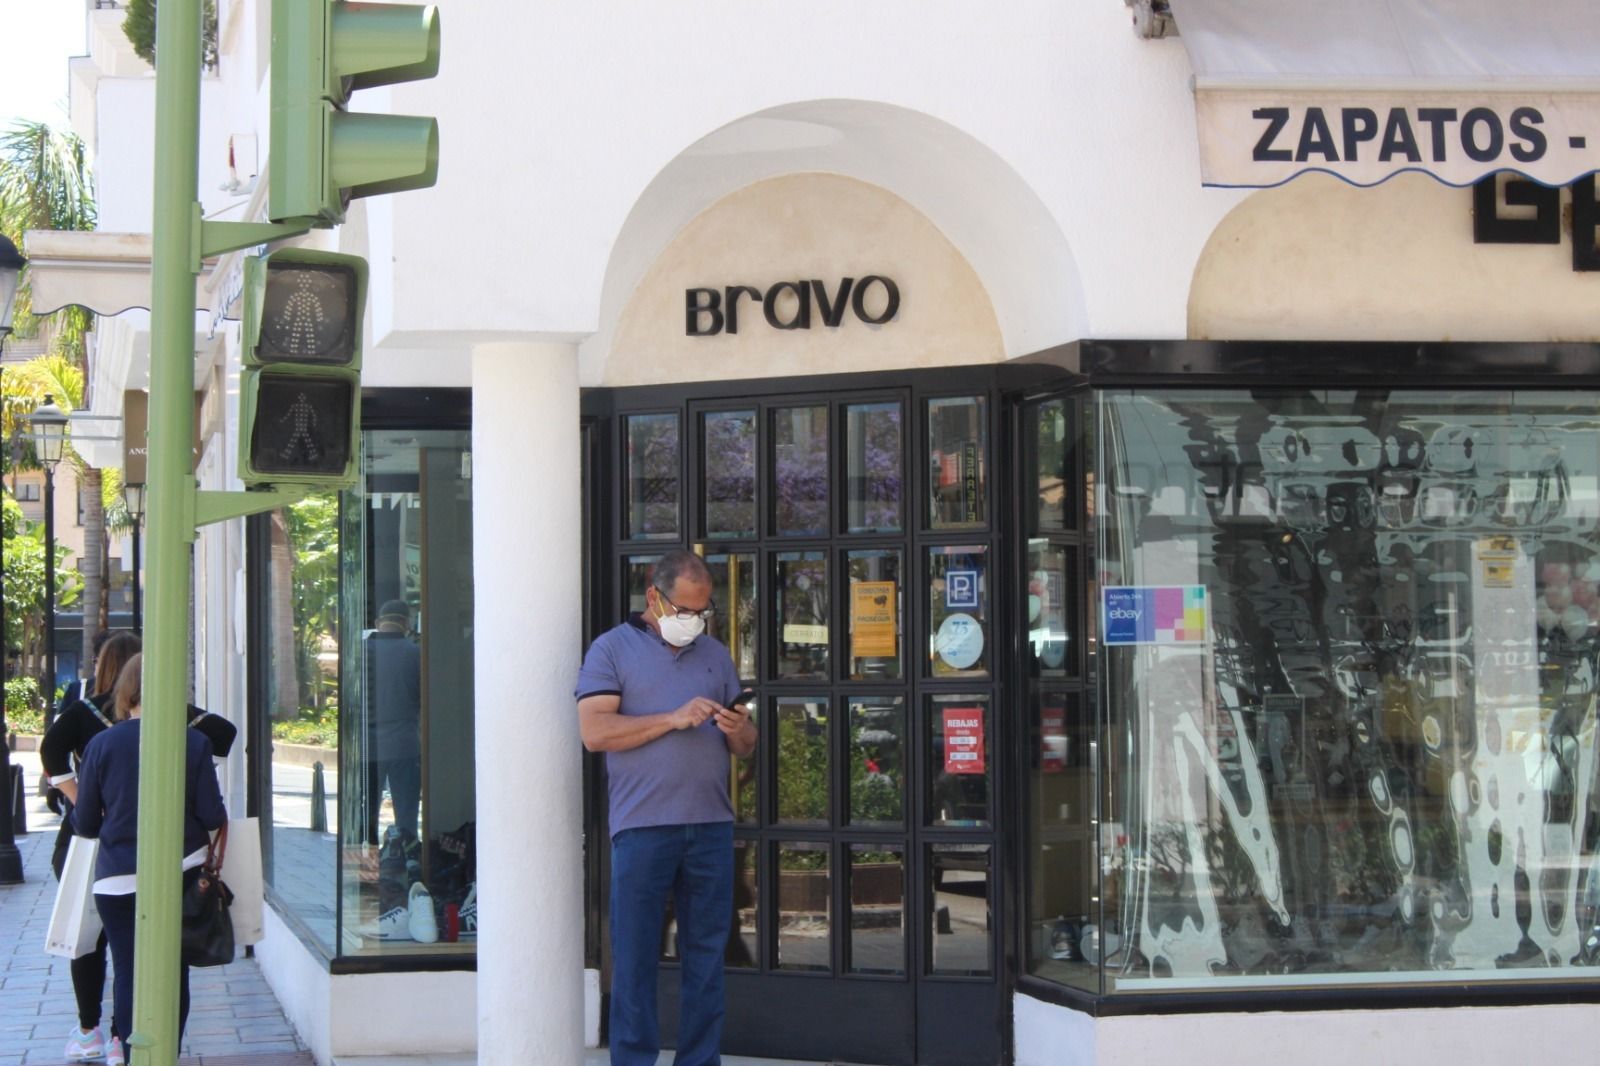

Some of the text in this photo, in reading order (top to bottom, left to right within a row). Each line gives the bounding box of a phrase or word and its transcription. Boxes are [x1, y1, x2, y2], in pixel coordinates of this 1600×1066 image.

[1252, 107, 1548, 163] ZAPATOS
[686, 275, 900, 336] Bravo
[1110, 608, 1142, 621] ebay
[947, 719, 979, 728] REBAJAS
